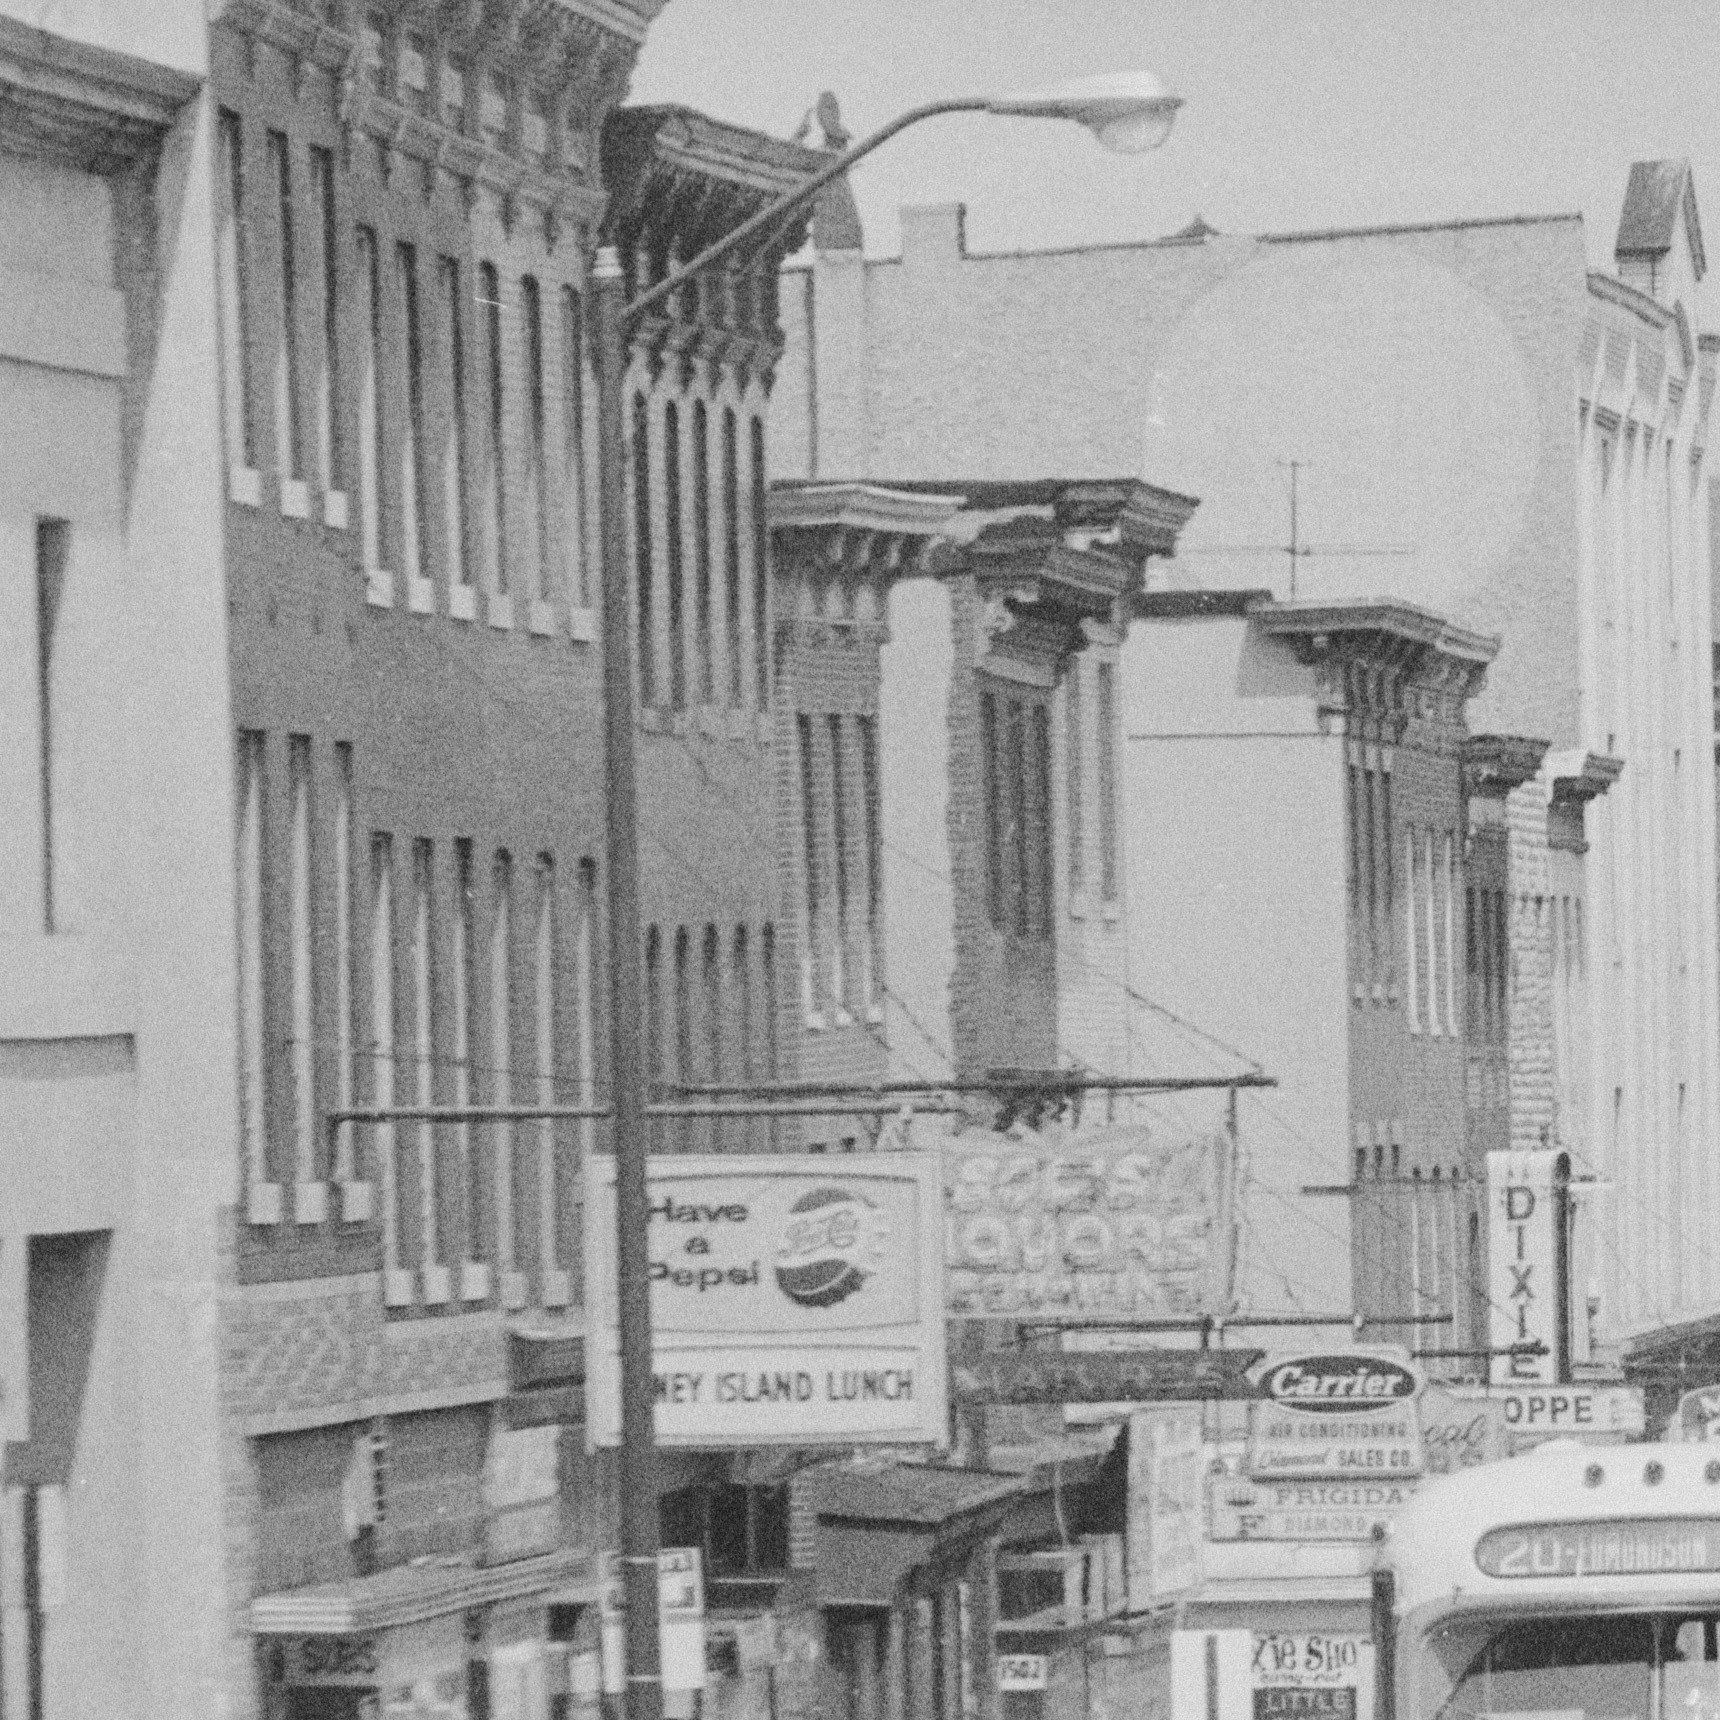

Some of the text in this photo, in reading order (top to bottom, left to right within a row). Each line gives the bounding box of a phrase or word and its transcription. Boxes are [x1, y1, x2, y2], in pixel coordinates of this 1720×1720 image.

[648, 1196, 748, 1223] Have
[684, 1236, 710, 1254] a
[648, 1260, 760, 1292] Pepsi
[1504, 1185, 1541, 1379] DIXIE
[652, 1371, 703, 1402] NEY
[716, 1371, 813, 1402] ISLAND
[826, 1369, 913, 1401] LUNCH
[1270, 1364, 1406, 1397] Carrier
[1504, 1395, 1594, 1424] OPPE
[1269, 1422, 1407, 1438] AIR CONDITIONING
[1338, 1449, 1384, 1468] SALES
[1276, 1488, 1406, 1505] FRIGIDA
[1266, 1692, 1349, 1713] LITTLE
